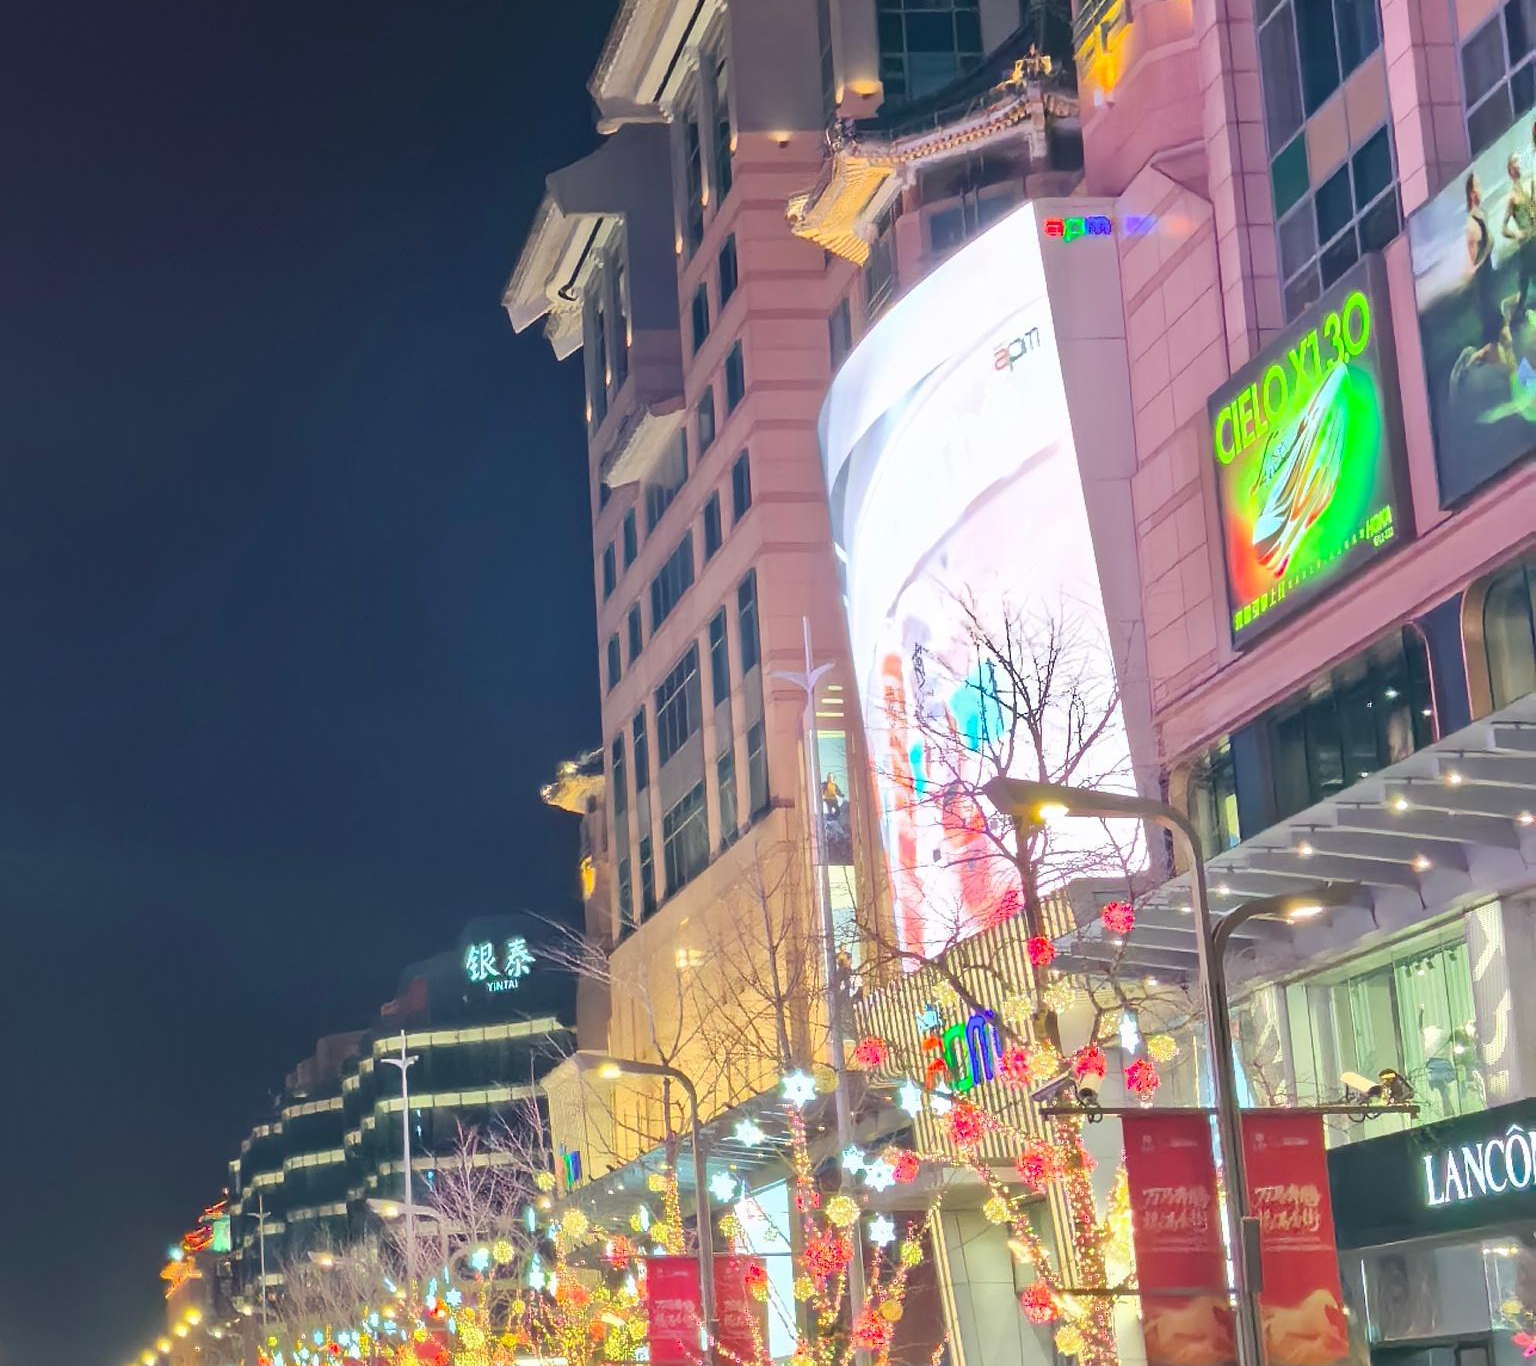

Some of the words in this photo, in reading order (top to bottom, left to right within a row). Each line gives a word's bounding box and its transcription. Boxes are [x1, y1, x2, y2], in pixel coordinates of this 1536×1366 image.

[1045, 215, 1112, 243] apm
[993, 327, 1041, 372] apm
[1215, 365, 1289, 465] CIELO
[1288, 329, 1323, 403] X1
[1324, 291, 1371, 373] 3.0
[465, 938, 537, 981] 银泰
[487, 979, 519, 992] YINTAI
